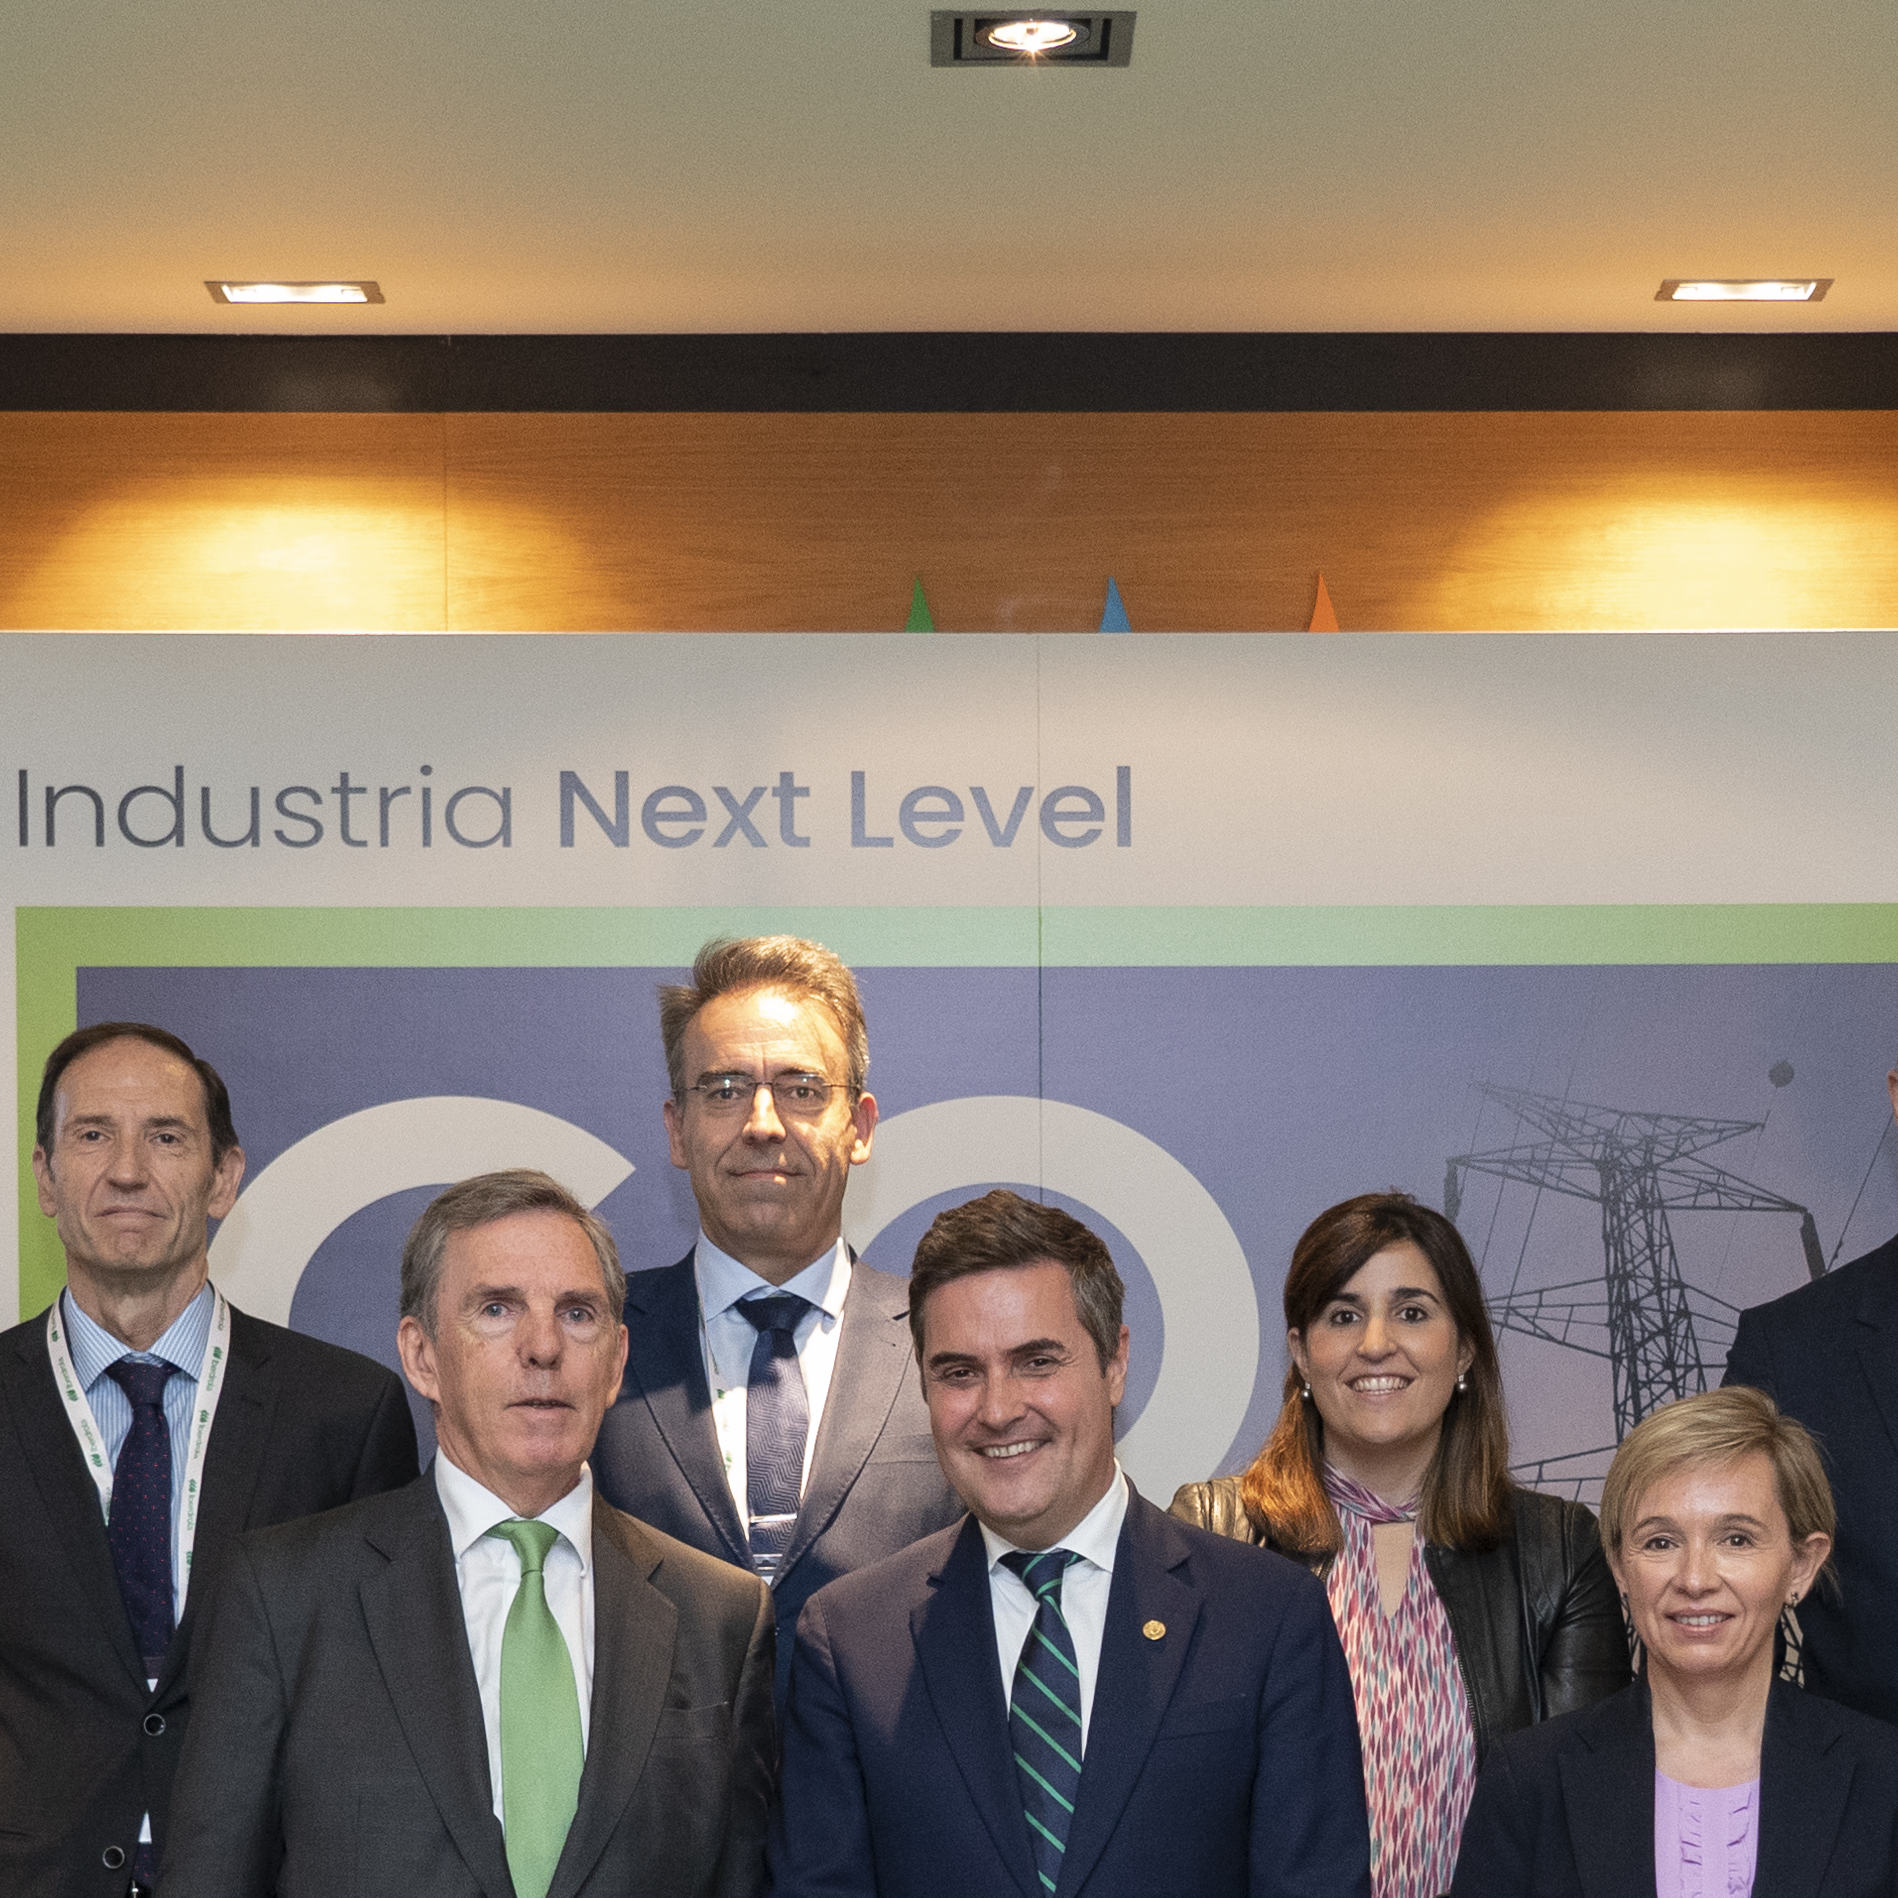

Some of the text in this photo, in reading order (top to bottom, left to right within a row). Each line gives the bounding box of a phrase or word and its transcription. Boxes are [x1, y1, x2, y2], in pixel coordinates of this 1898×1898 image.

[16, 764, 1133, 851] Industria Next Level
